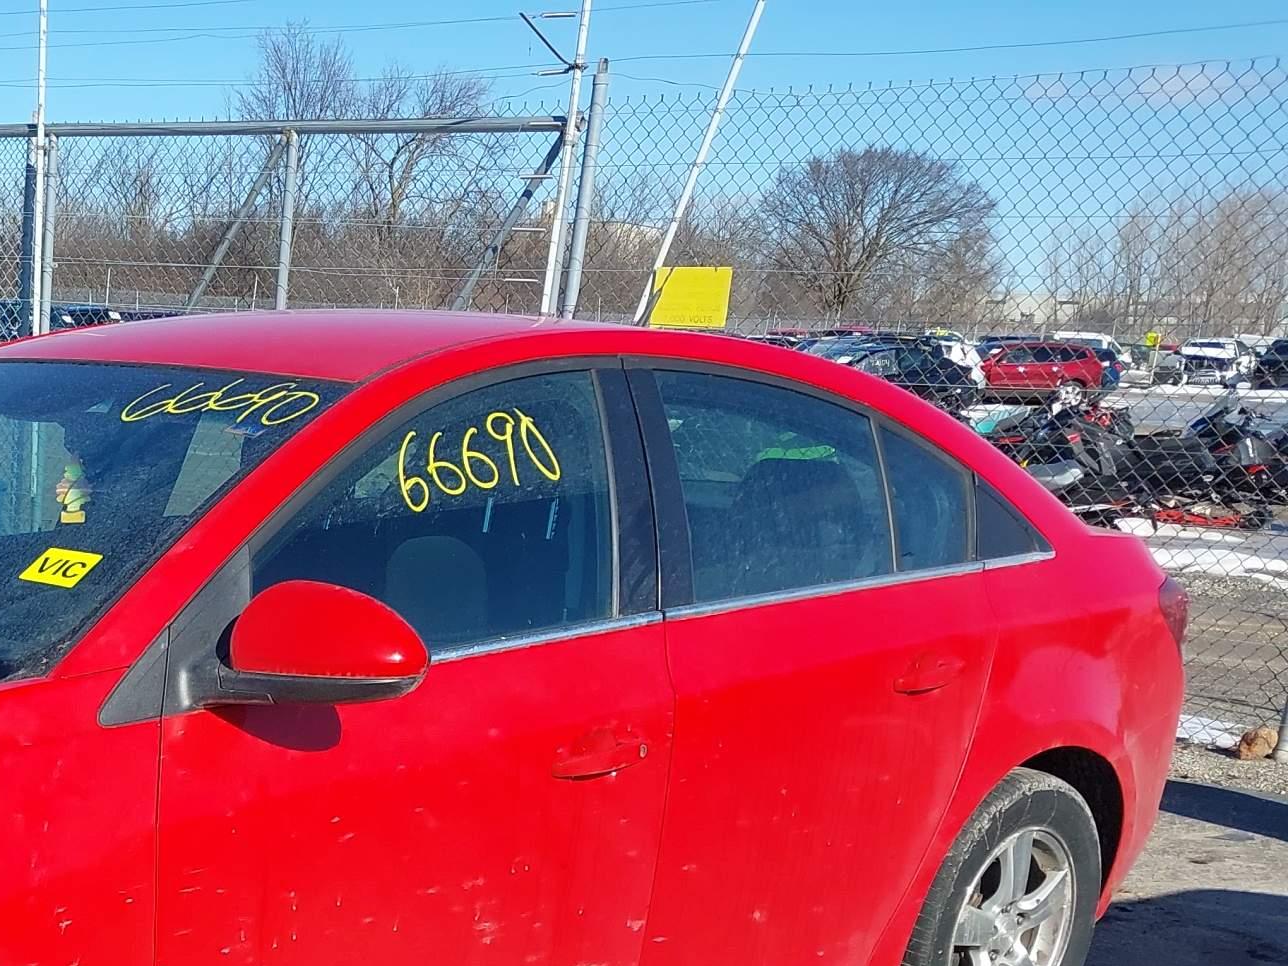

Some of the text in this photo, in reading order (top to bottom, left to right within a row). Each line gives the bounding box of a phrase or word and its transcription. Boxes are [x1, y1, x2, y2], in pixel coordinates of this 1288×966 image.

[688, 315, 713, 324] VOLTS
[398, 408, 561, 512] 66690
[38, 556, 87, 578] VIC
